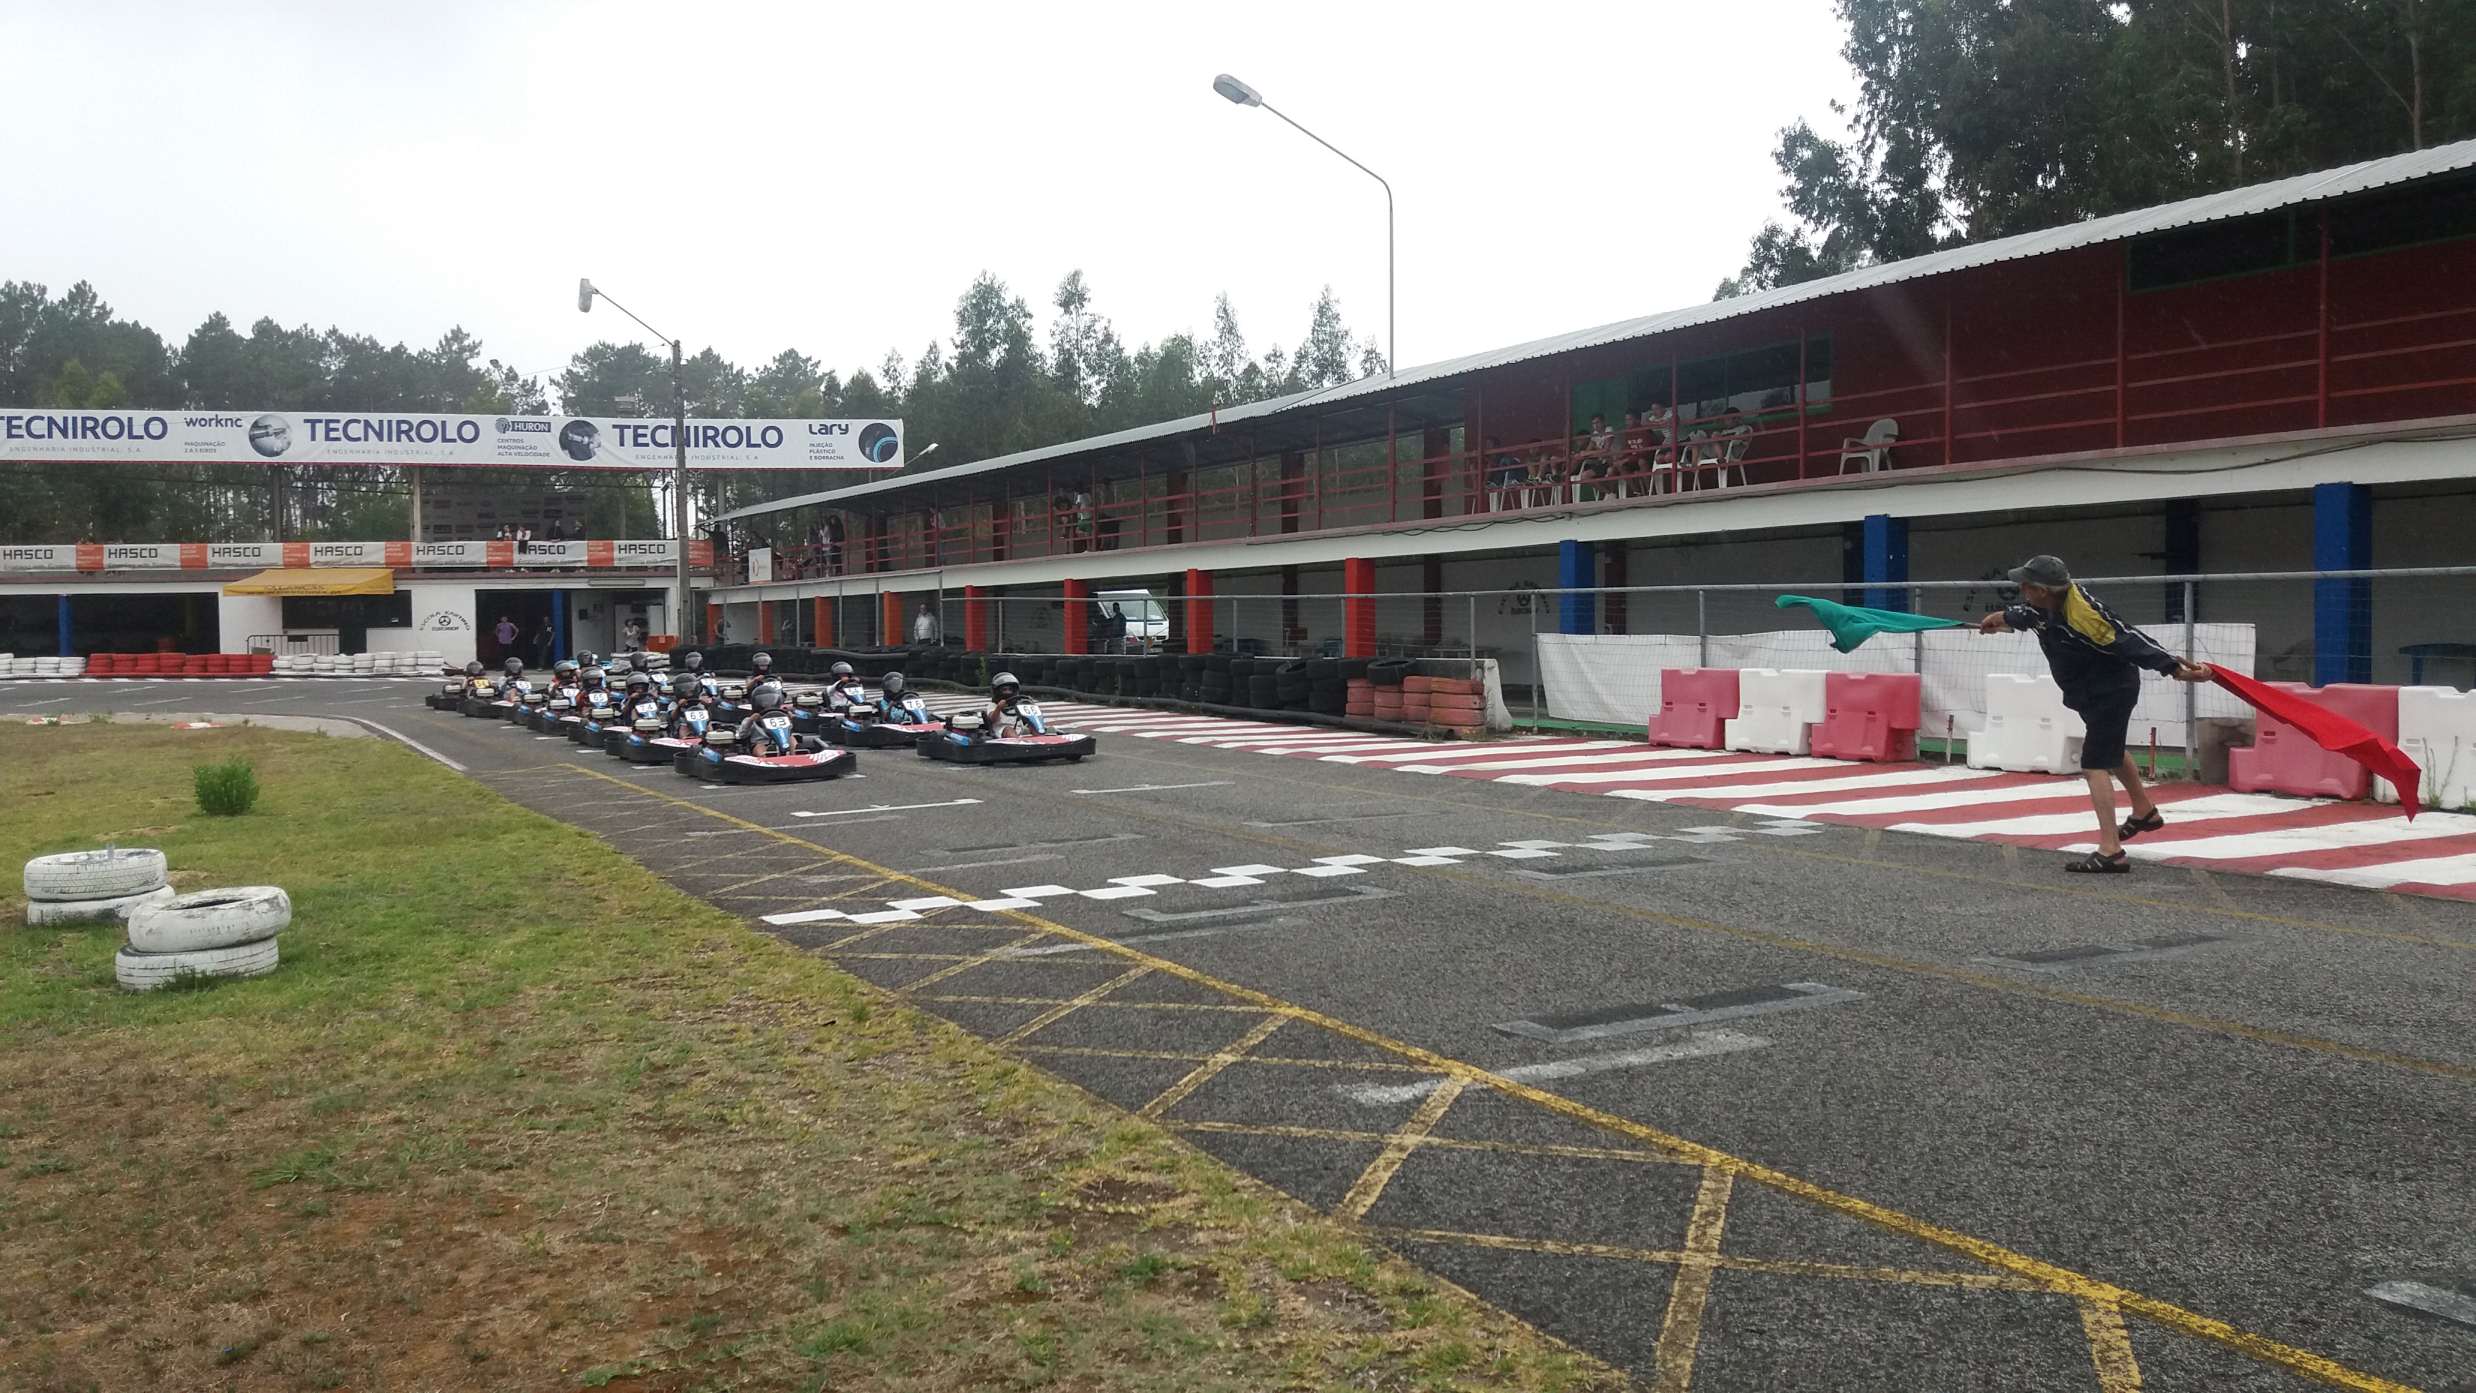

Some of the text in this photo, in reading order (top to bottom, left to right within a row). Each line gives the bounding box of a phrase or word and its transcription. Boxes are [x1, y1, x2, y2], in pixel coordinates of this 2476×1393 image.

[184, 413, 243, 428] worknc
[0, 415, 168, 440] ECNIROLO
[303, 418, 480, 444] TECNIROLO
[514, 422, 548, 432] HURON
[612, 424, 784, 449] TECNIROLO
[3, 548, 54, 560] HASCO
[108, 548, 158, 559] HASCO
[211, 546, 261, 557] HASCO
[314, 545, 363, 556] HASCO
[416, 545, 465, 556] HASCO
[518, 544, 566, 555] ASCO
[618, 543, 666, 554] HASCO
[769, 718, 786, 727] 63
